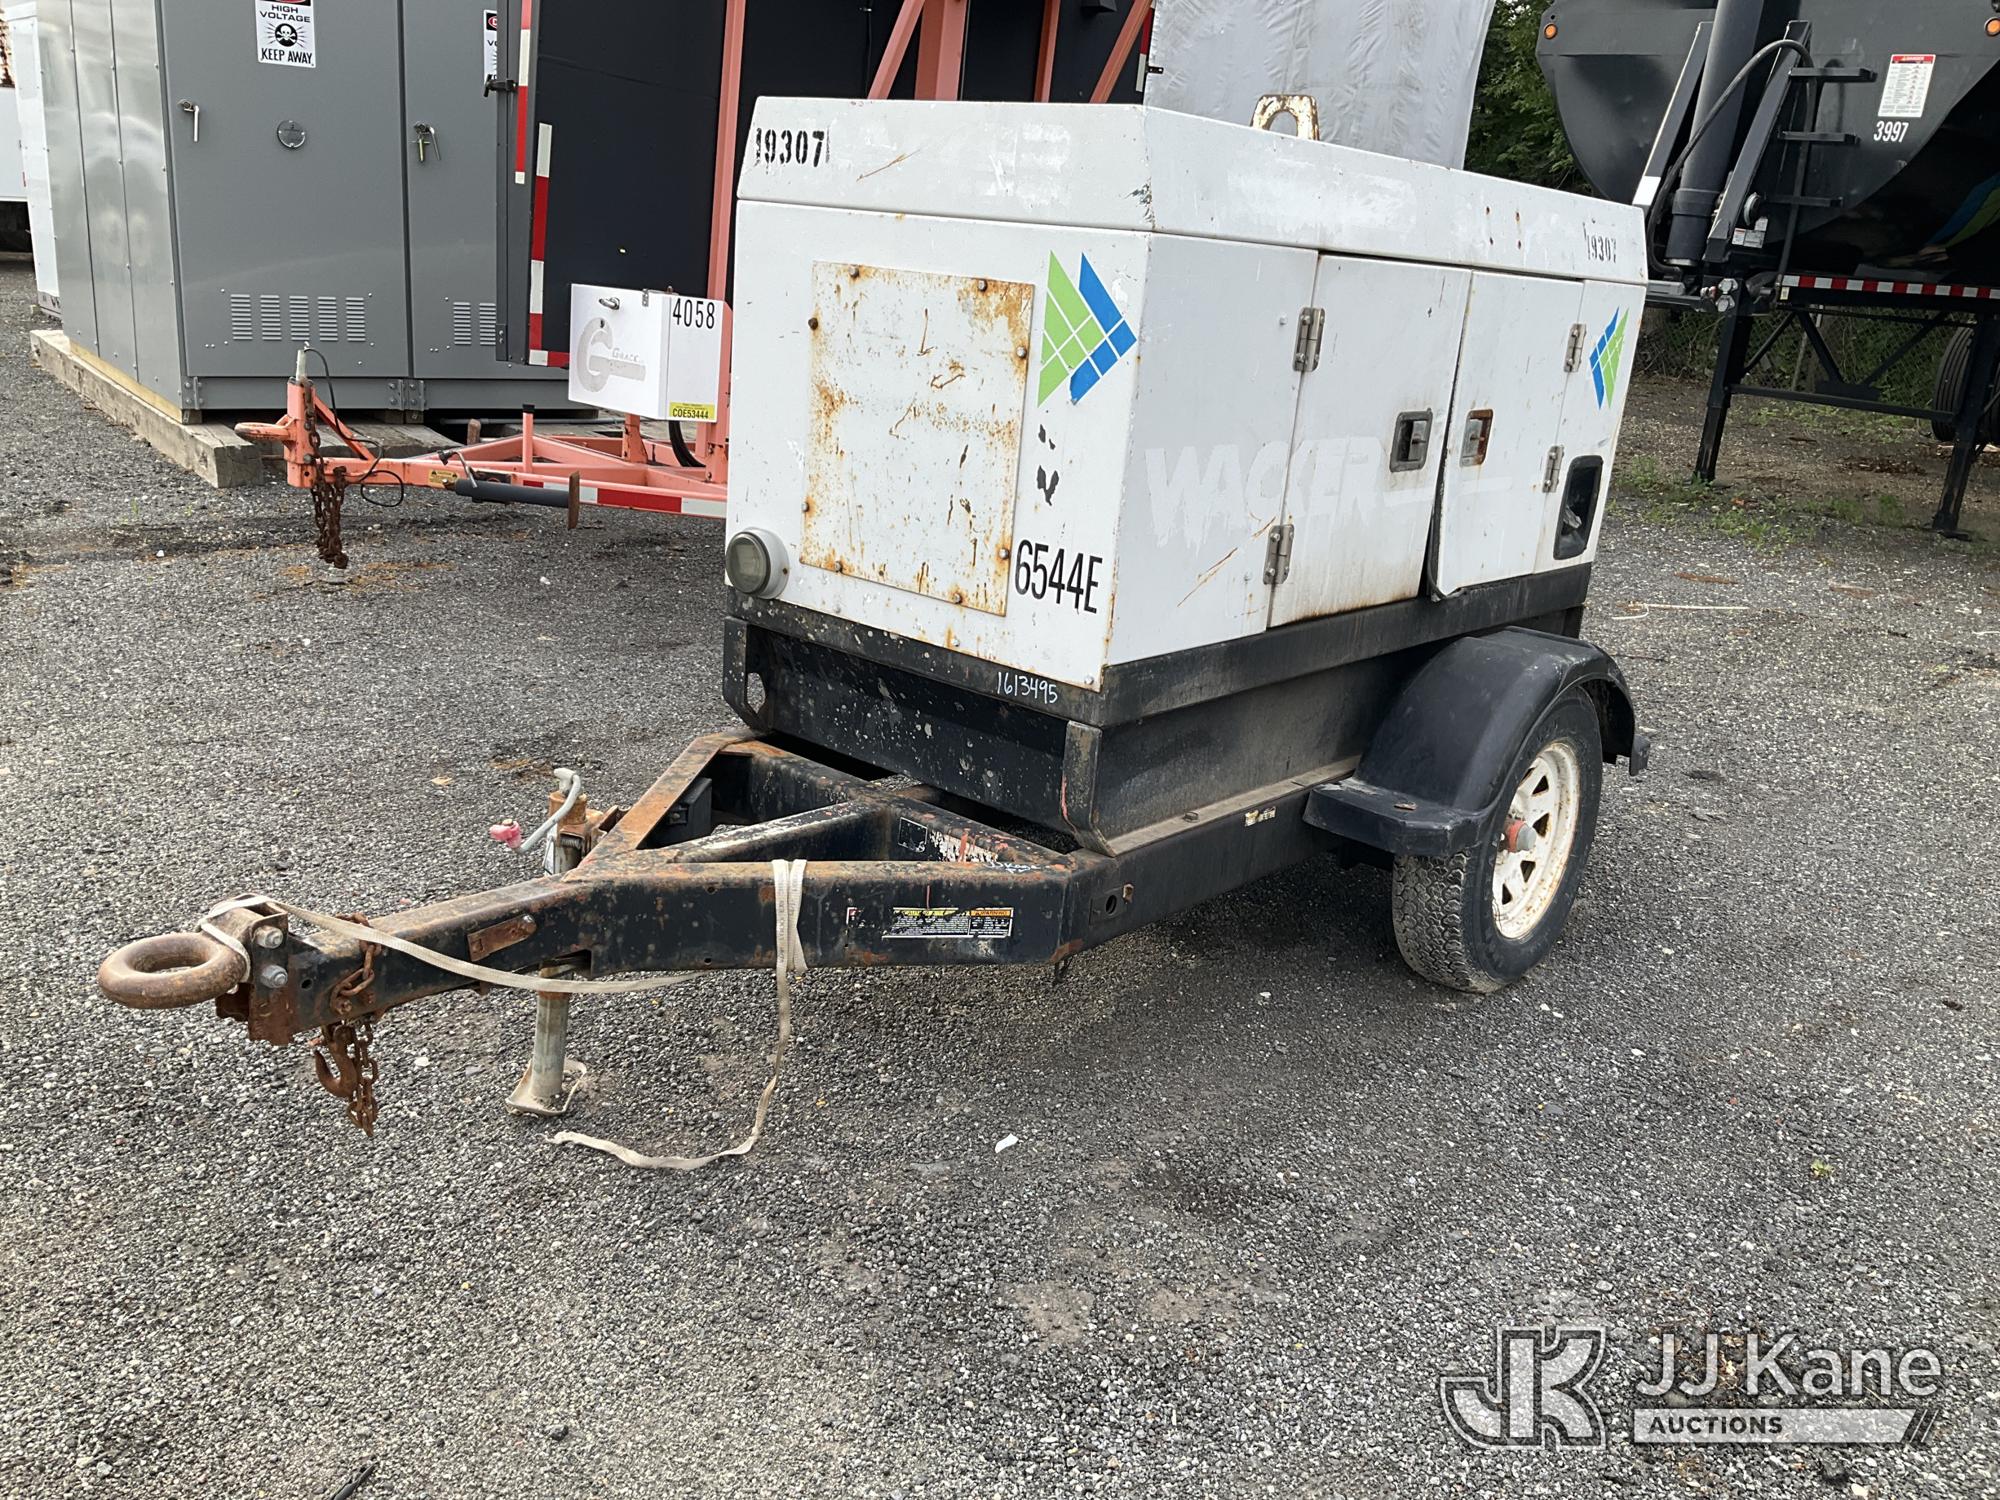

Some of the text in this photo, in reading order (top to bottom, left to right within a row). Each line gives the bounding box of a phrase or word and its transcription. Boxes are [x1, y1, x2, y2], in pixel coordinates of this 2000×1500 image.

[260, 11, 311, 23] VOLTAGE
[271, 4, 299, 13] HIGH
[261, 47, 312, 64] KEEP AWAY
[1873, 120, 1909, 143] 3997
[673, 298, 715, 329] 4058
[1015, 539, 1103, 614] 6544E
[997, 671, 1058, 704] 1613495
